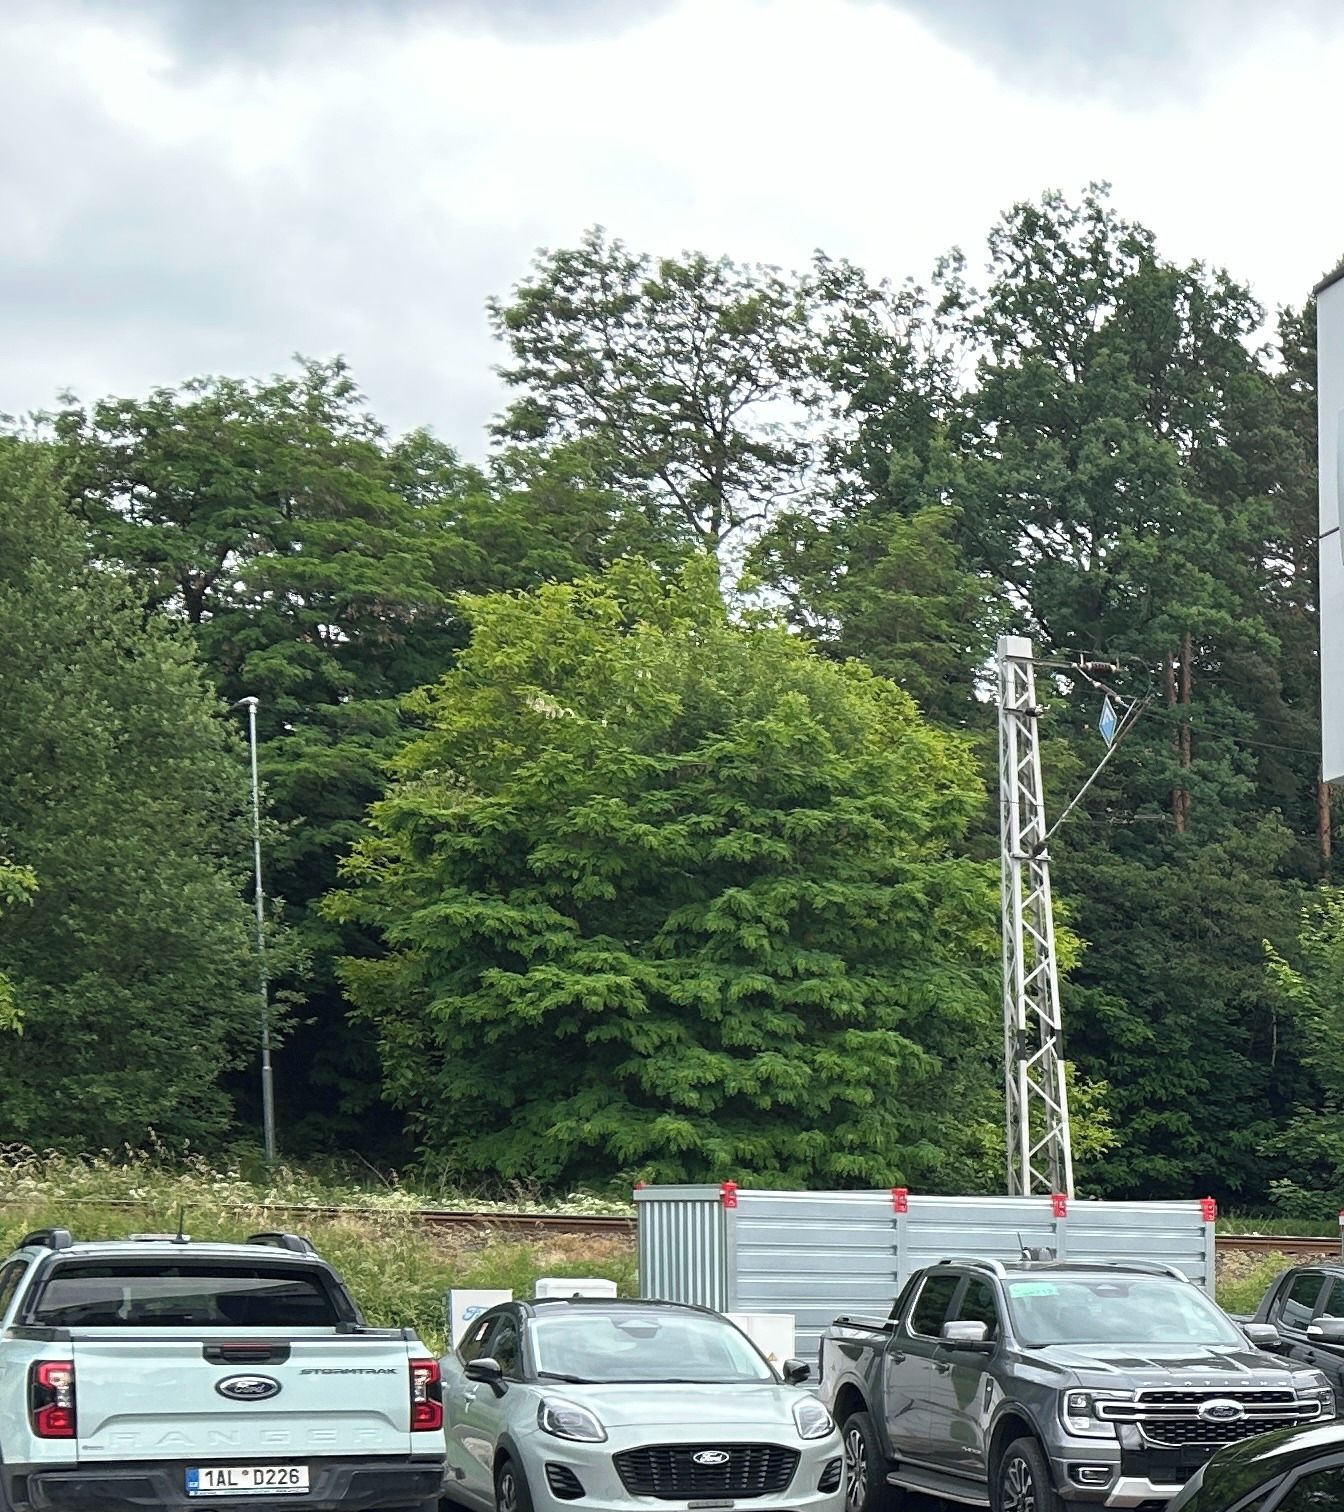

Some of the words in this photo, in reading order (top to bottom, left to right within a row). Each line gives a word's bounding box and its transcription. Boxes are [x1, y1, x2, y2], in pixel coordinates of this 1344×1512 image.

[110, 1429, 384, 1448] RANGER
[204, 1469, 239, 1487] 1AL
[253, 1468, 300, 1486] D226
